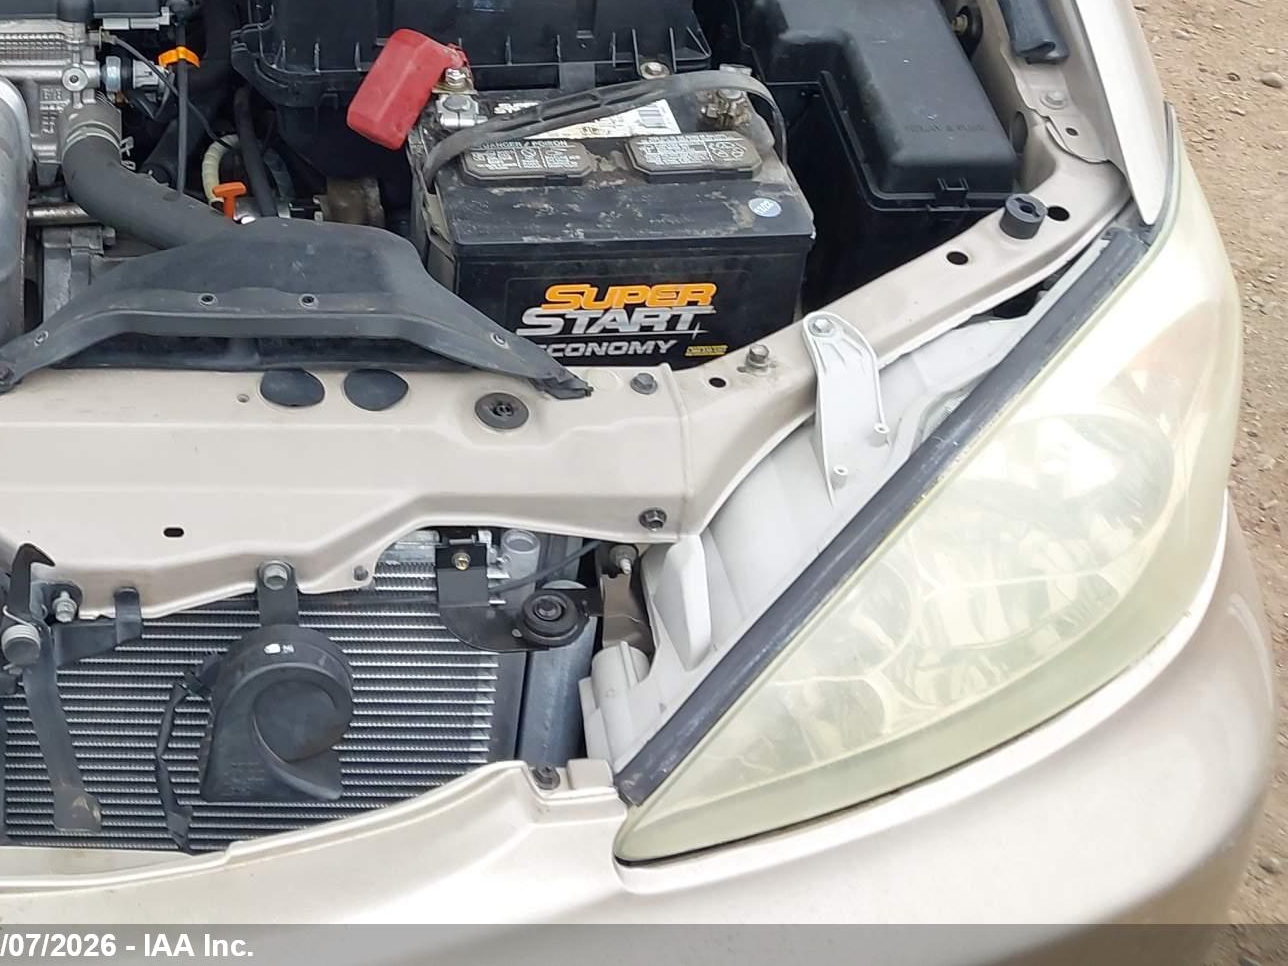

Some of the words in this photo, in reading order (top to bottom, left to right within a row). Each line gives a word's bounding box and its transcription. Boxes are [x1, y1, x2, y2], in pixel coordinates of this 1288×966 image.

[540, 282, 717, 310] SUPER
[516, 305, 716, 336] START
[536, 339, 678, 357] CONOMY
